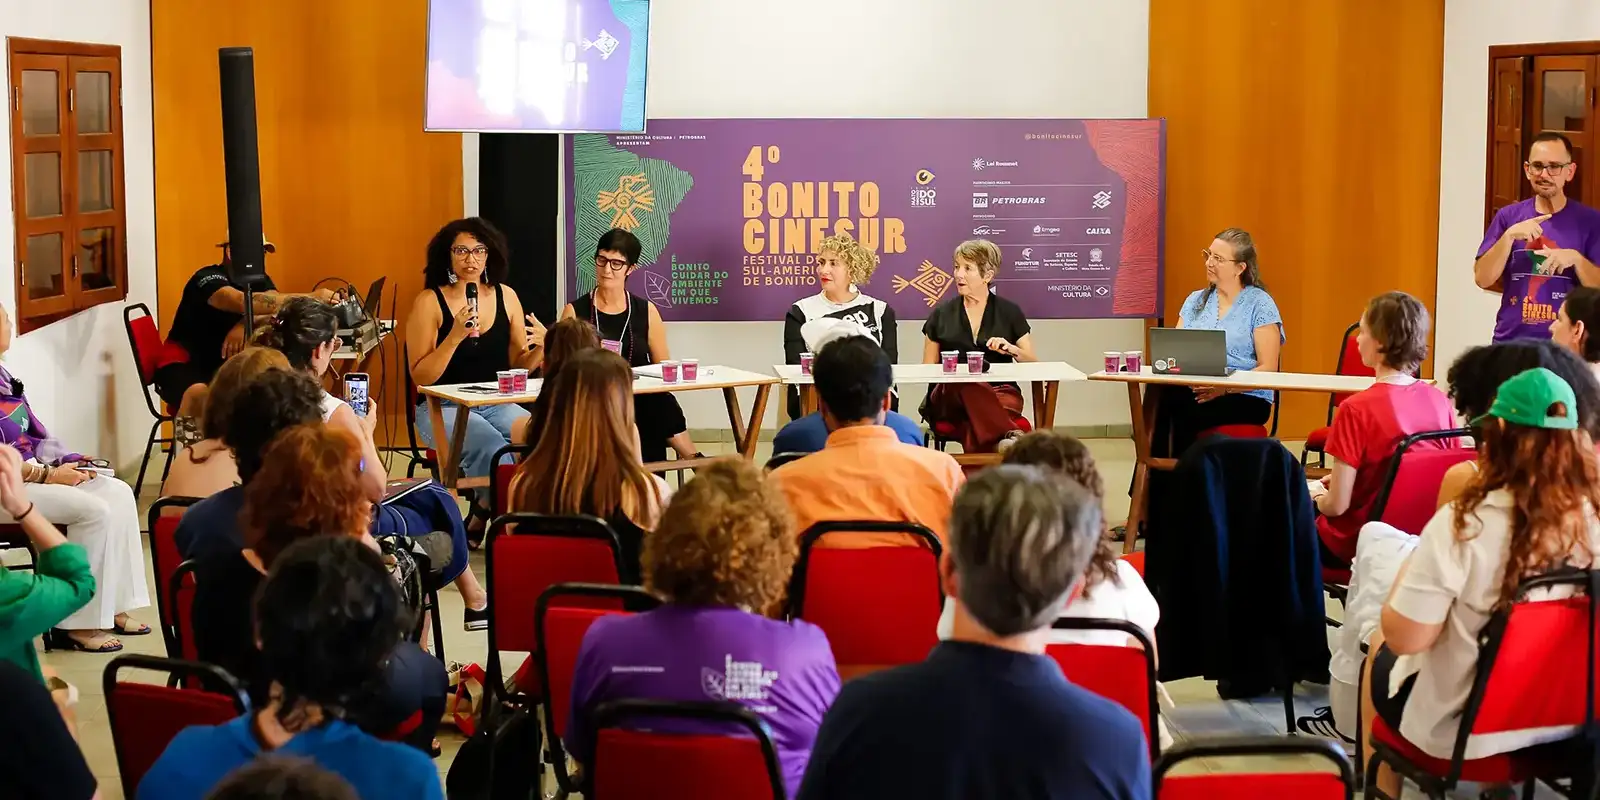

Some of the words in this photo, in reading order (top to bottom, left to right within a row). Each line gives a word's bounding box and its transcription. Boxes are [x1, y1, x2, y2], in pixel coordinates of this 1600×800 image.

[920, 189, 936, 198] DO
[743, 181, 880, 218] BONITO
[920, 198, 936, 206] SUL
[1086, 227, 1111, 235] CAIXA
[743, 255, 801, 265] FESTIVAL
[671, 263, 710, 271] BONITO
[671, 271, 710, 279] CUIDAR
[714, 271, 729, 279] DO
[671, 280, 722, 288] AMBIENTE
[743, 277, 760, 286] DE
[765, 277, 816, 286] BONITO
[671, 288, 686, 296] EM
[690, 288, 710, 297] QUE
[671, 297, 719, 305] VIVEMOS
[1522, 303, 1552, 312] BONITO
